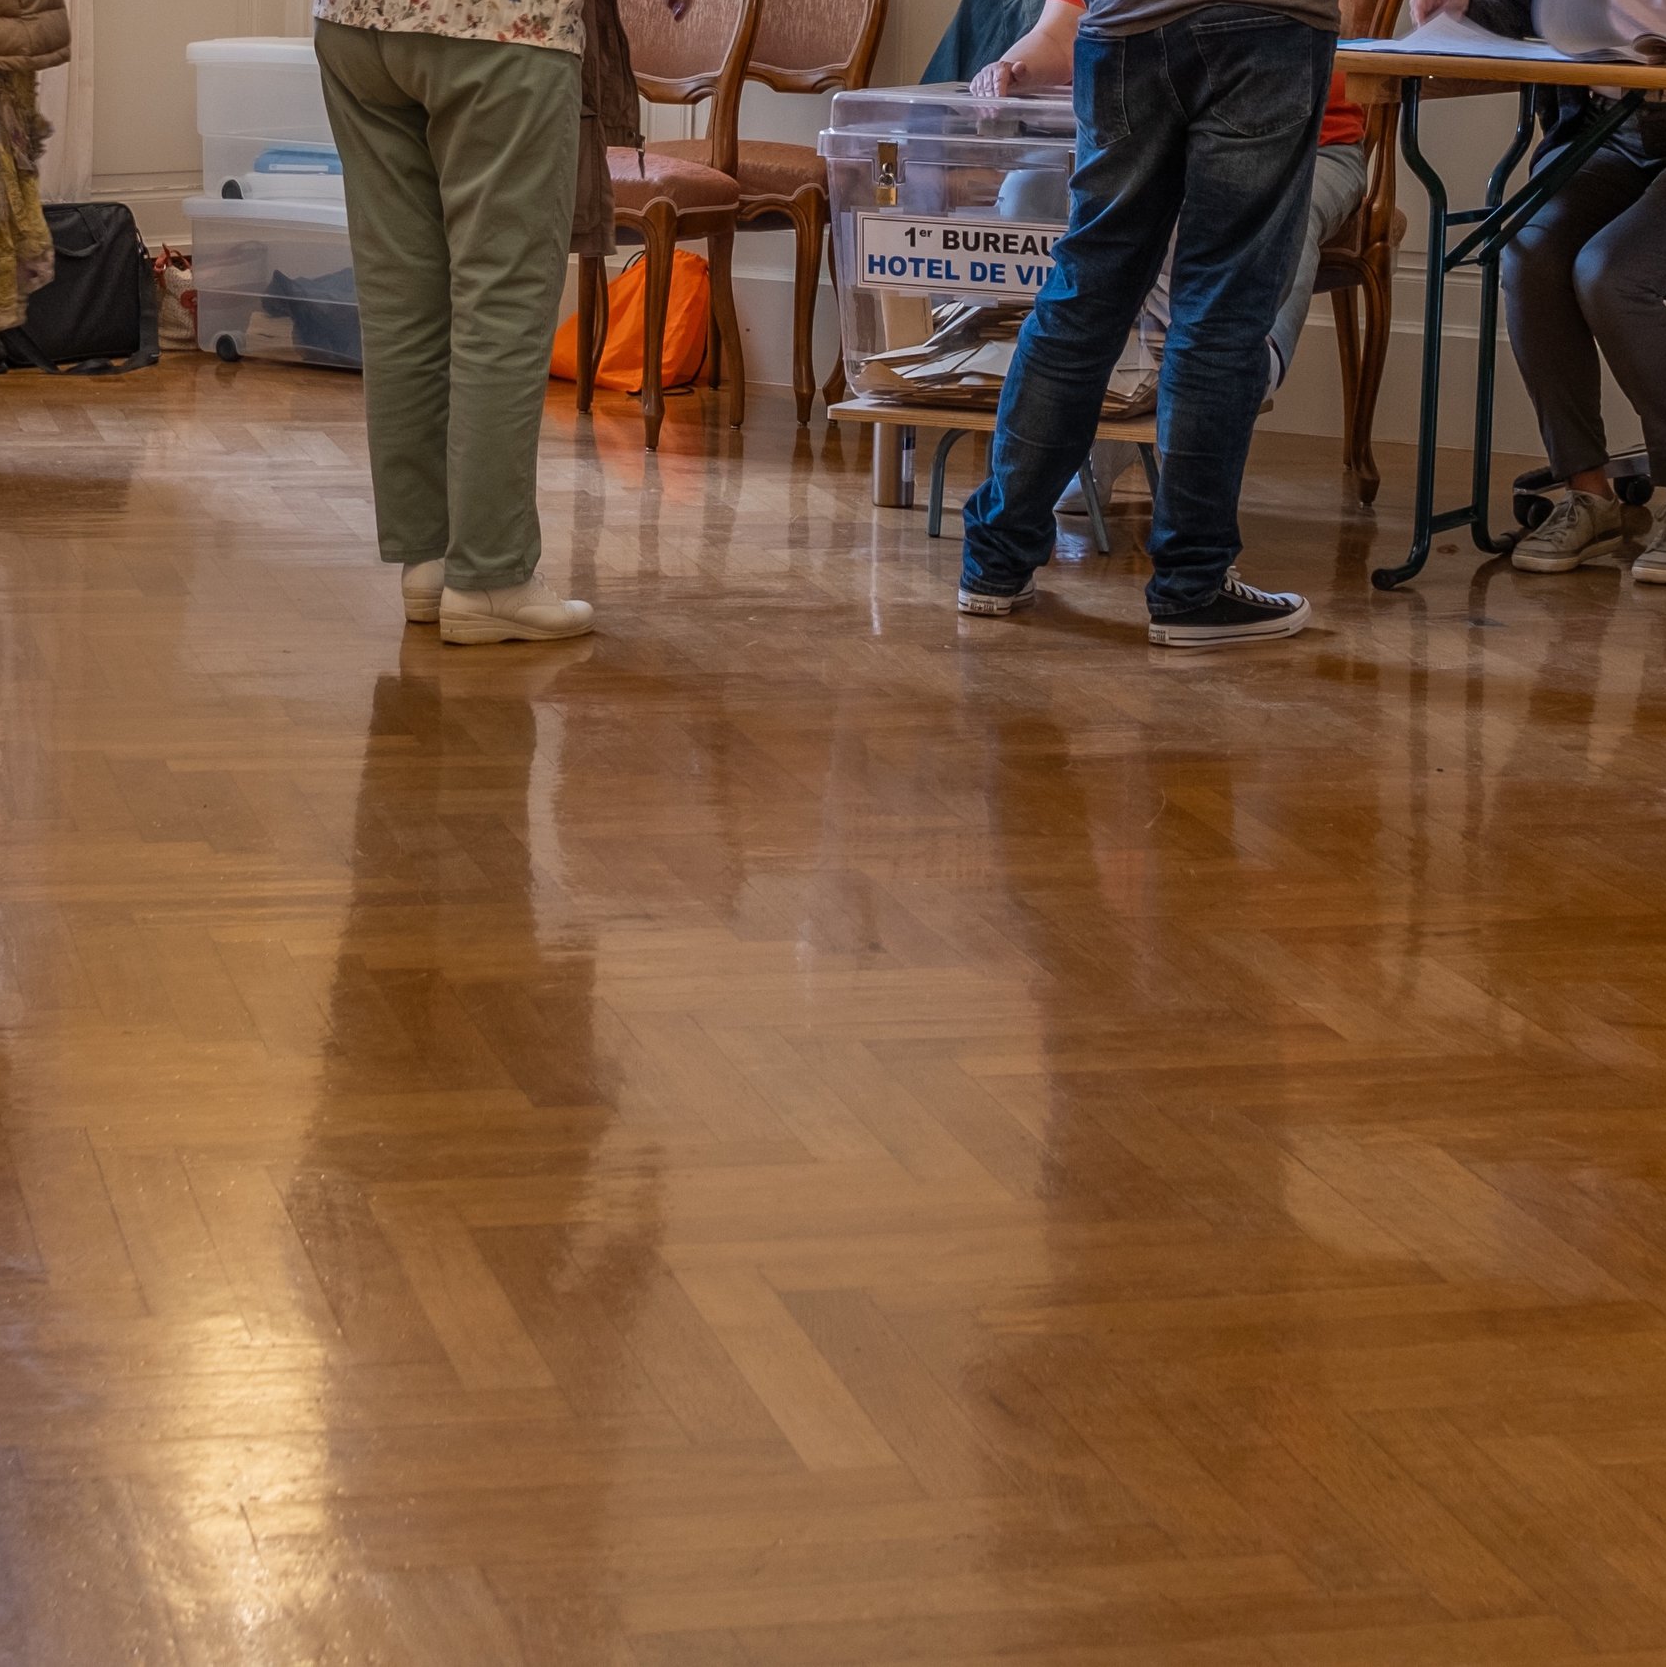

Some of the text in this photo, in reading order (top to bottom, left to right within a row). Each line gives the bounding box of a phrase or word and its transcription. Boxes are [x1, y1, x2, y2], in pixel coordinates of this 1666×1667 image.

[904, 226, 933, 247] 1er
[867, 254, 960, 281] HOTEL
[970, 261, 1006, 284] DE
